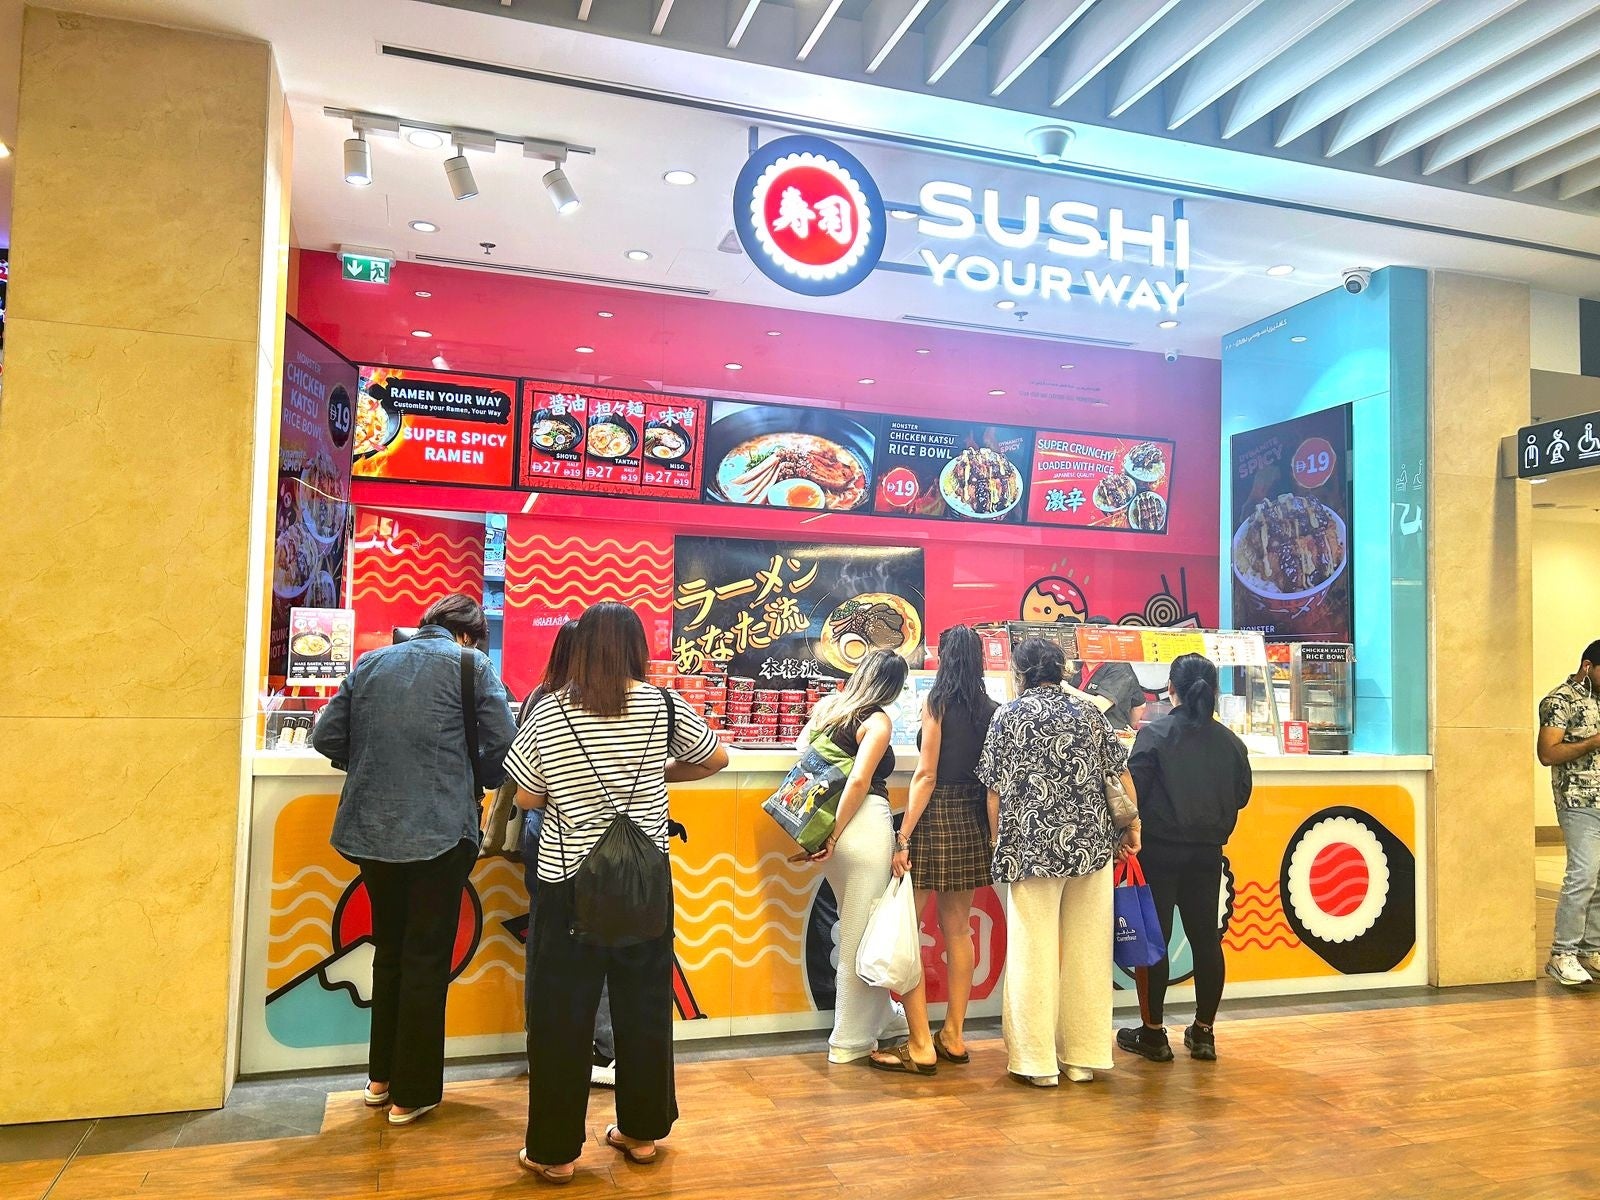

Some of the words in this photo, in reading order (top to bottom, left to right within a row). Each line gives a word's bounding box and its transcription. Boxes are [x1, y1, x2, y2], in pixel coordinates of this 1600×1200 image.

[772, 185, 853, 245] 寿司
[917, 180, 1191, 271] SUSHI
[918, 248, 1074, 302] YOUR
[1082, 269, 1190, 314] WAY
[287, 363, 326, 401] CHICKEN
[290, 388, 319, 418] KATSU
[390, 387, 435, 401] RAMEN
[438, 392, 472, 405] YOUR
[476, 395, 502, 407] WAY
[393, 401, 428, 410] Customize
[446, 405, 470, 414] Ramen,
[488, 410, 501, 418] Way
[283, 407, 300, 429] RICE
[302, 419, 323, 440] BOWL
[892, 422, 919, 430] MONSTER
[403, 427, 457, 443] SUPER
[461, 432, 507, 448] SPICY
[890, 431, 927, 443] CHICKEN
[928, 435, 955, 445] KATSU
[1000, 444, 1021, 453] SPICY
[425, 447, 484, 464] RAMEN
[615, 458, 638, 466] TANTAN
[889, 444, 916, 456] RICE
[919, 447, 953, 460] BOWL
[1037, 439, 1069, 452] SUPER
[1069, 443, 1116, 463] CRUNCHY!
[1239, 444, 1283, 479] SPICY
[1037, 461, 1072, 471] LOADED
[1072, 462, 1094, 471] WITH
[1096, 464, 1115, 475] RICE
[673, 554, 820, 632] ラーメン
[672, 596, 811, 675] あなた流
[759, 656, 823, 680] 本格派
